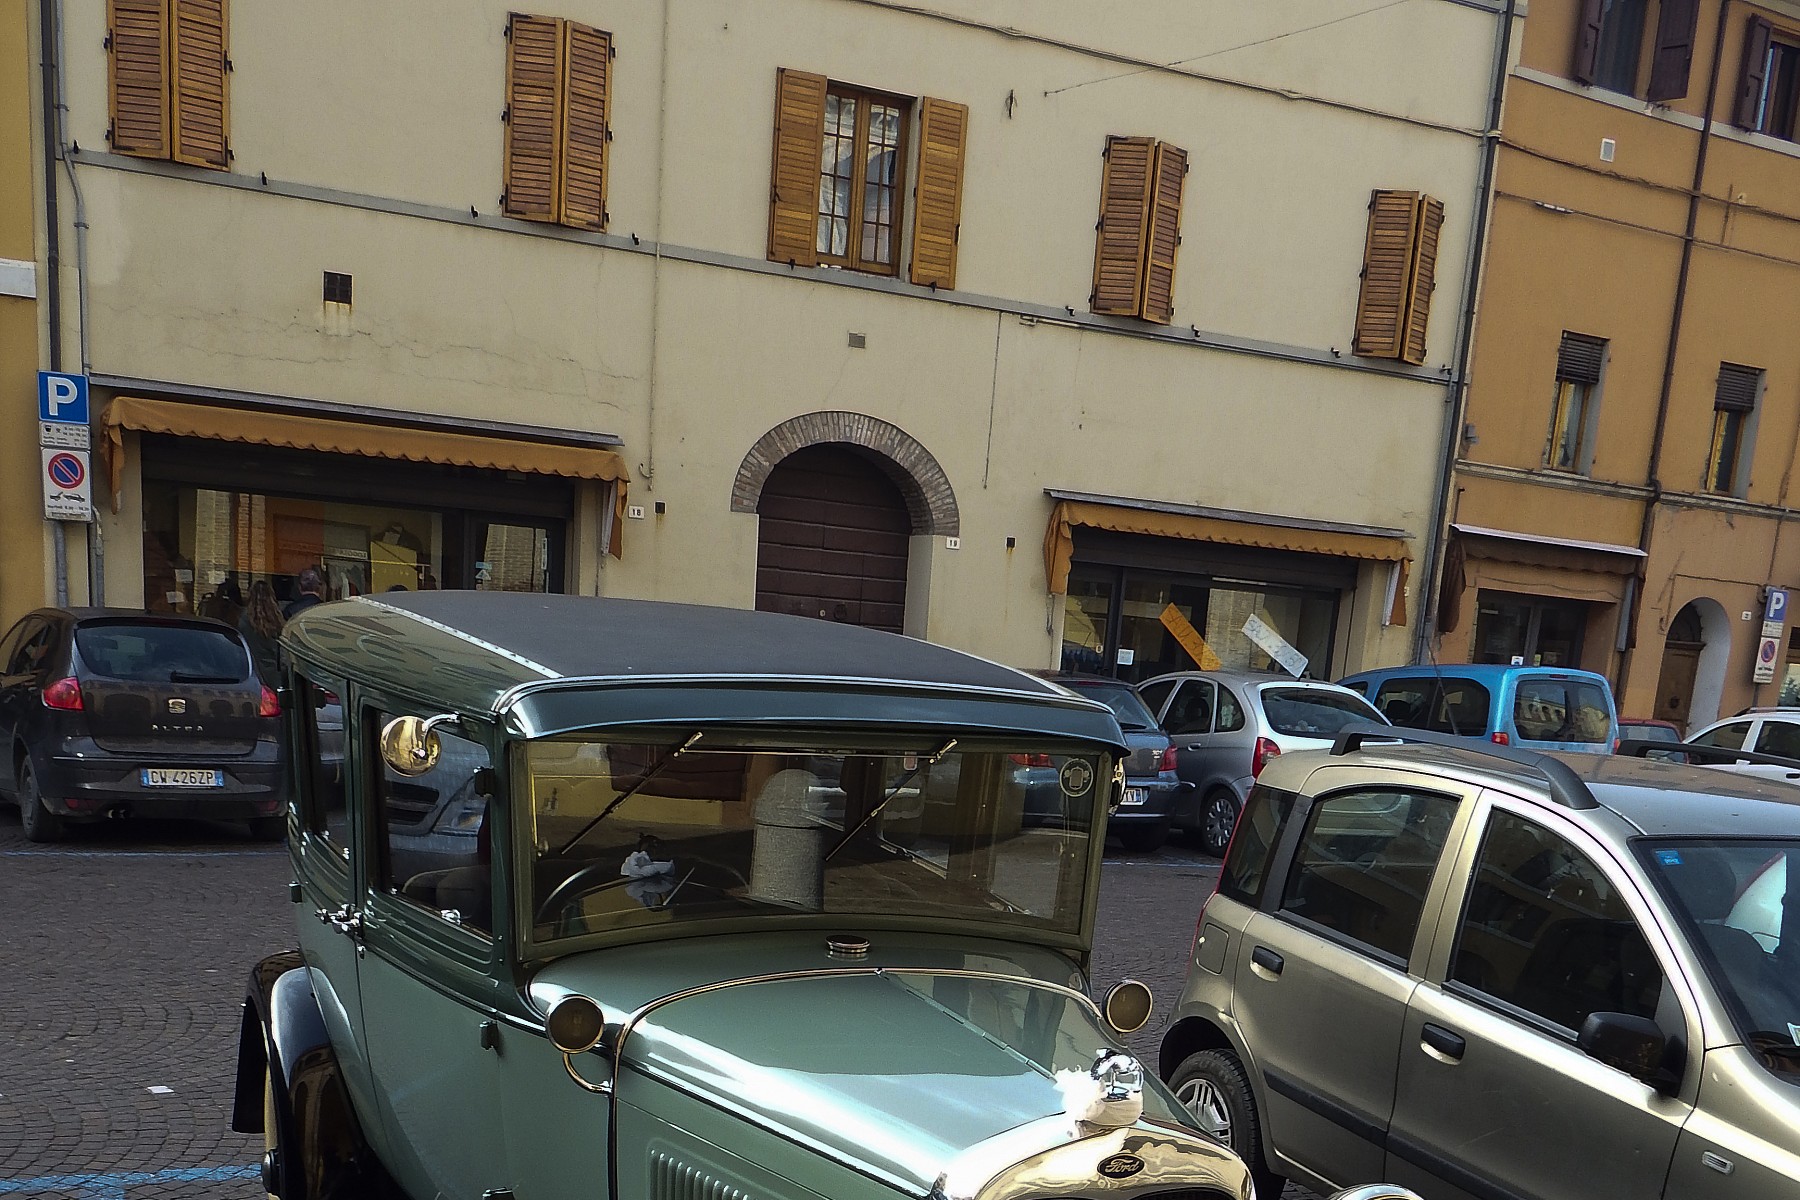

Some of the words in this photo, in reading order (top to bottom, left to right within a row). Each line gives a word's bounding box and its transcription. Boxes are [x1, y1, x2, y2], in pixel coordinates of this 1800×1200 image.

[47, 376, 78, 416] P
[1769, 592, 1785, 617] P
[1104, 1158, 1140, 1173] Ford
